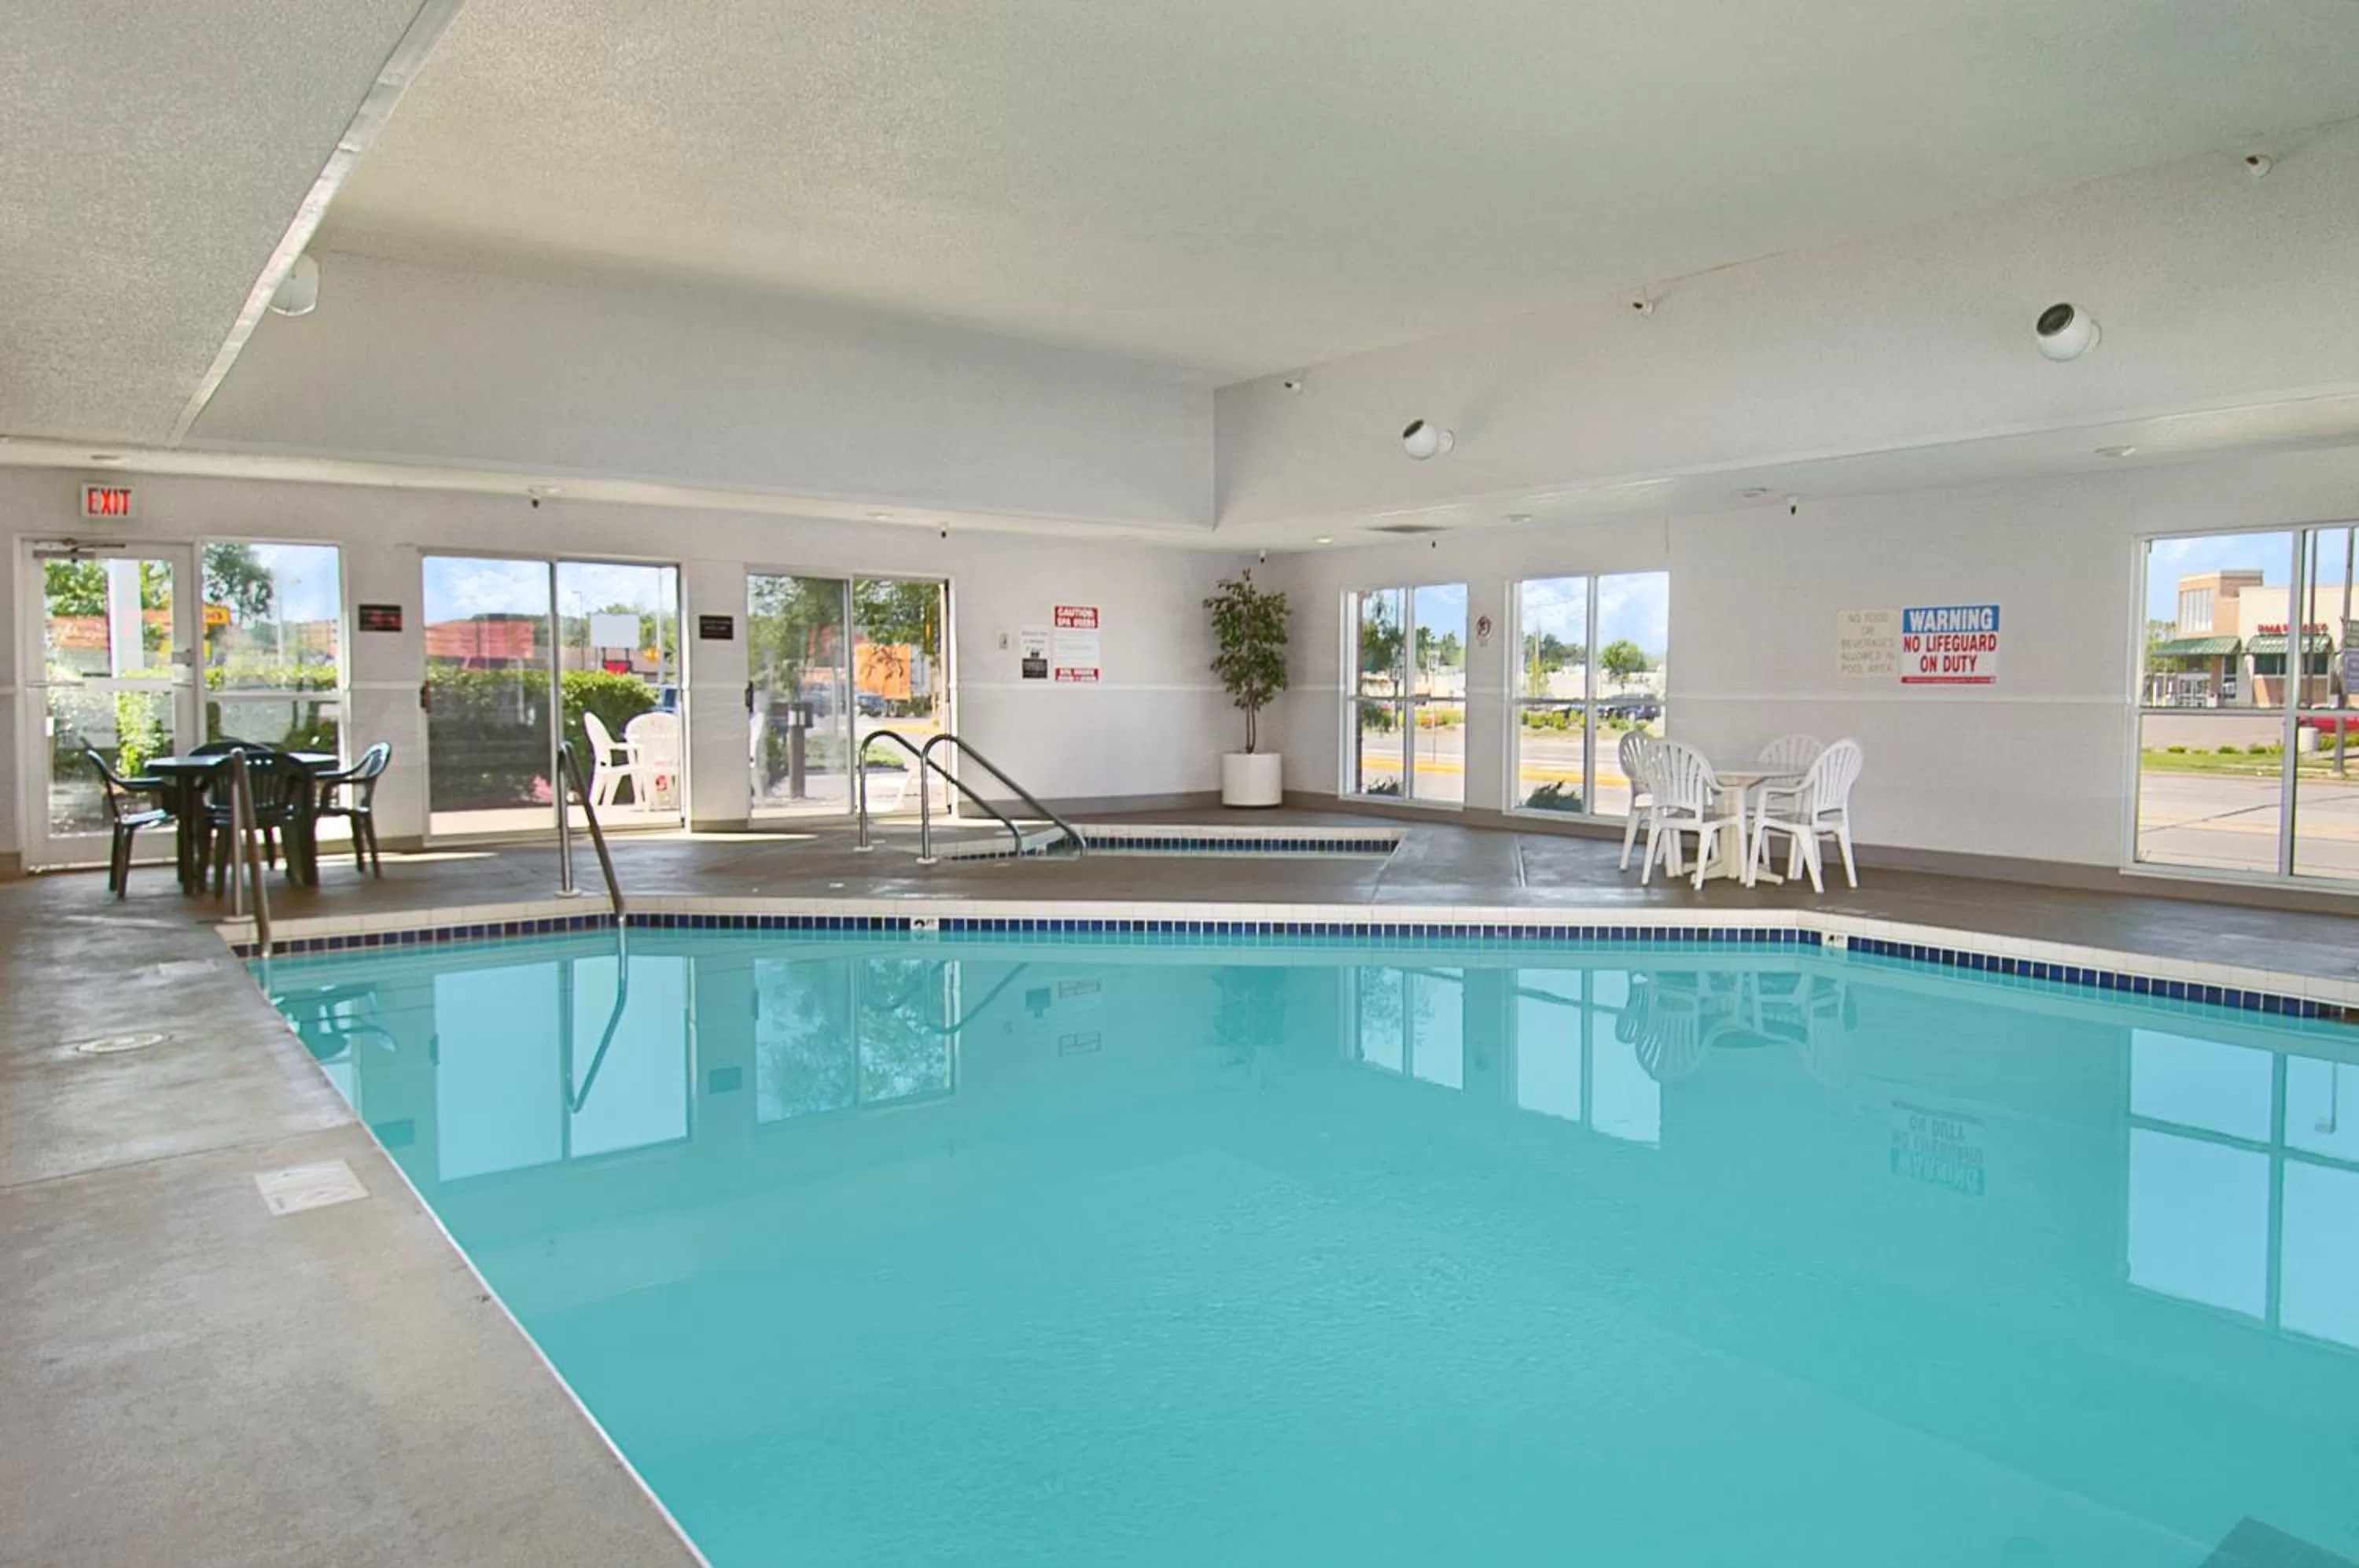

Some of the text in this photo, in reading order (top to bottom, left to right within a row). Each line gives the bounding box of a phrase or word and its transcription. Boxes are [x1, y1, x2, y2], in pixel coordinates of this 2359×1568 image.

[87, 487, 132, 516] EXIT
[1908, 608, 1993, 631] WARNING
[1903, 634, 1997, 653] NO LIFEGUARD
[1919, 654, 1978, 672] ON DUTY
